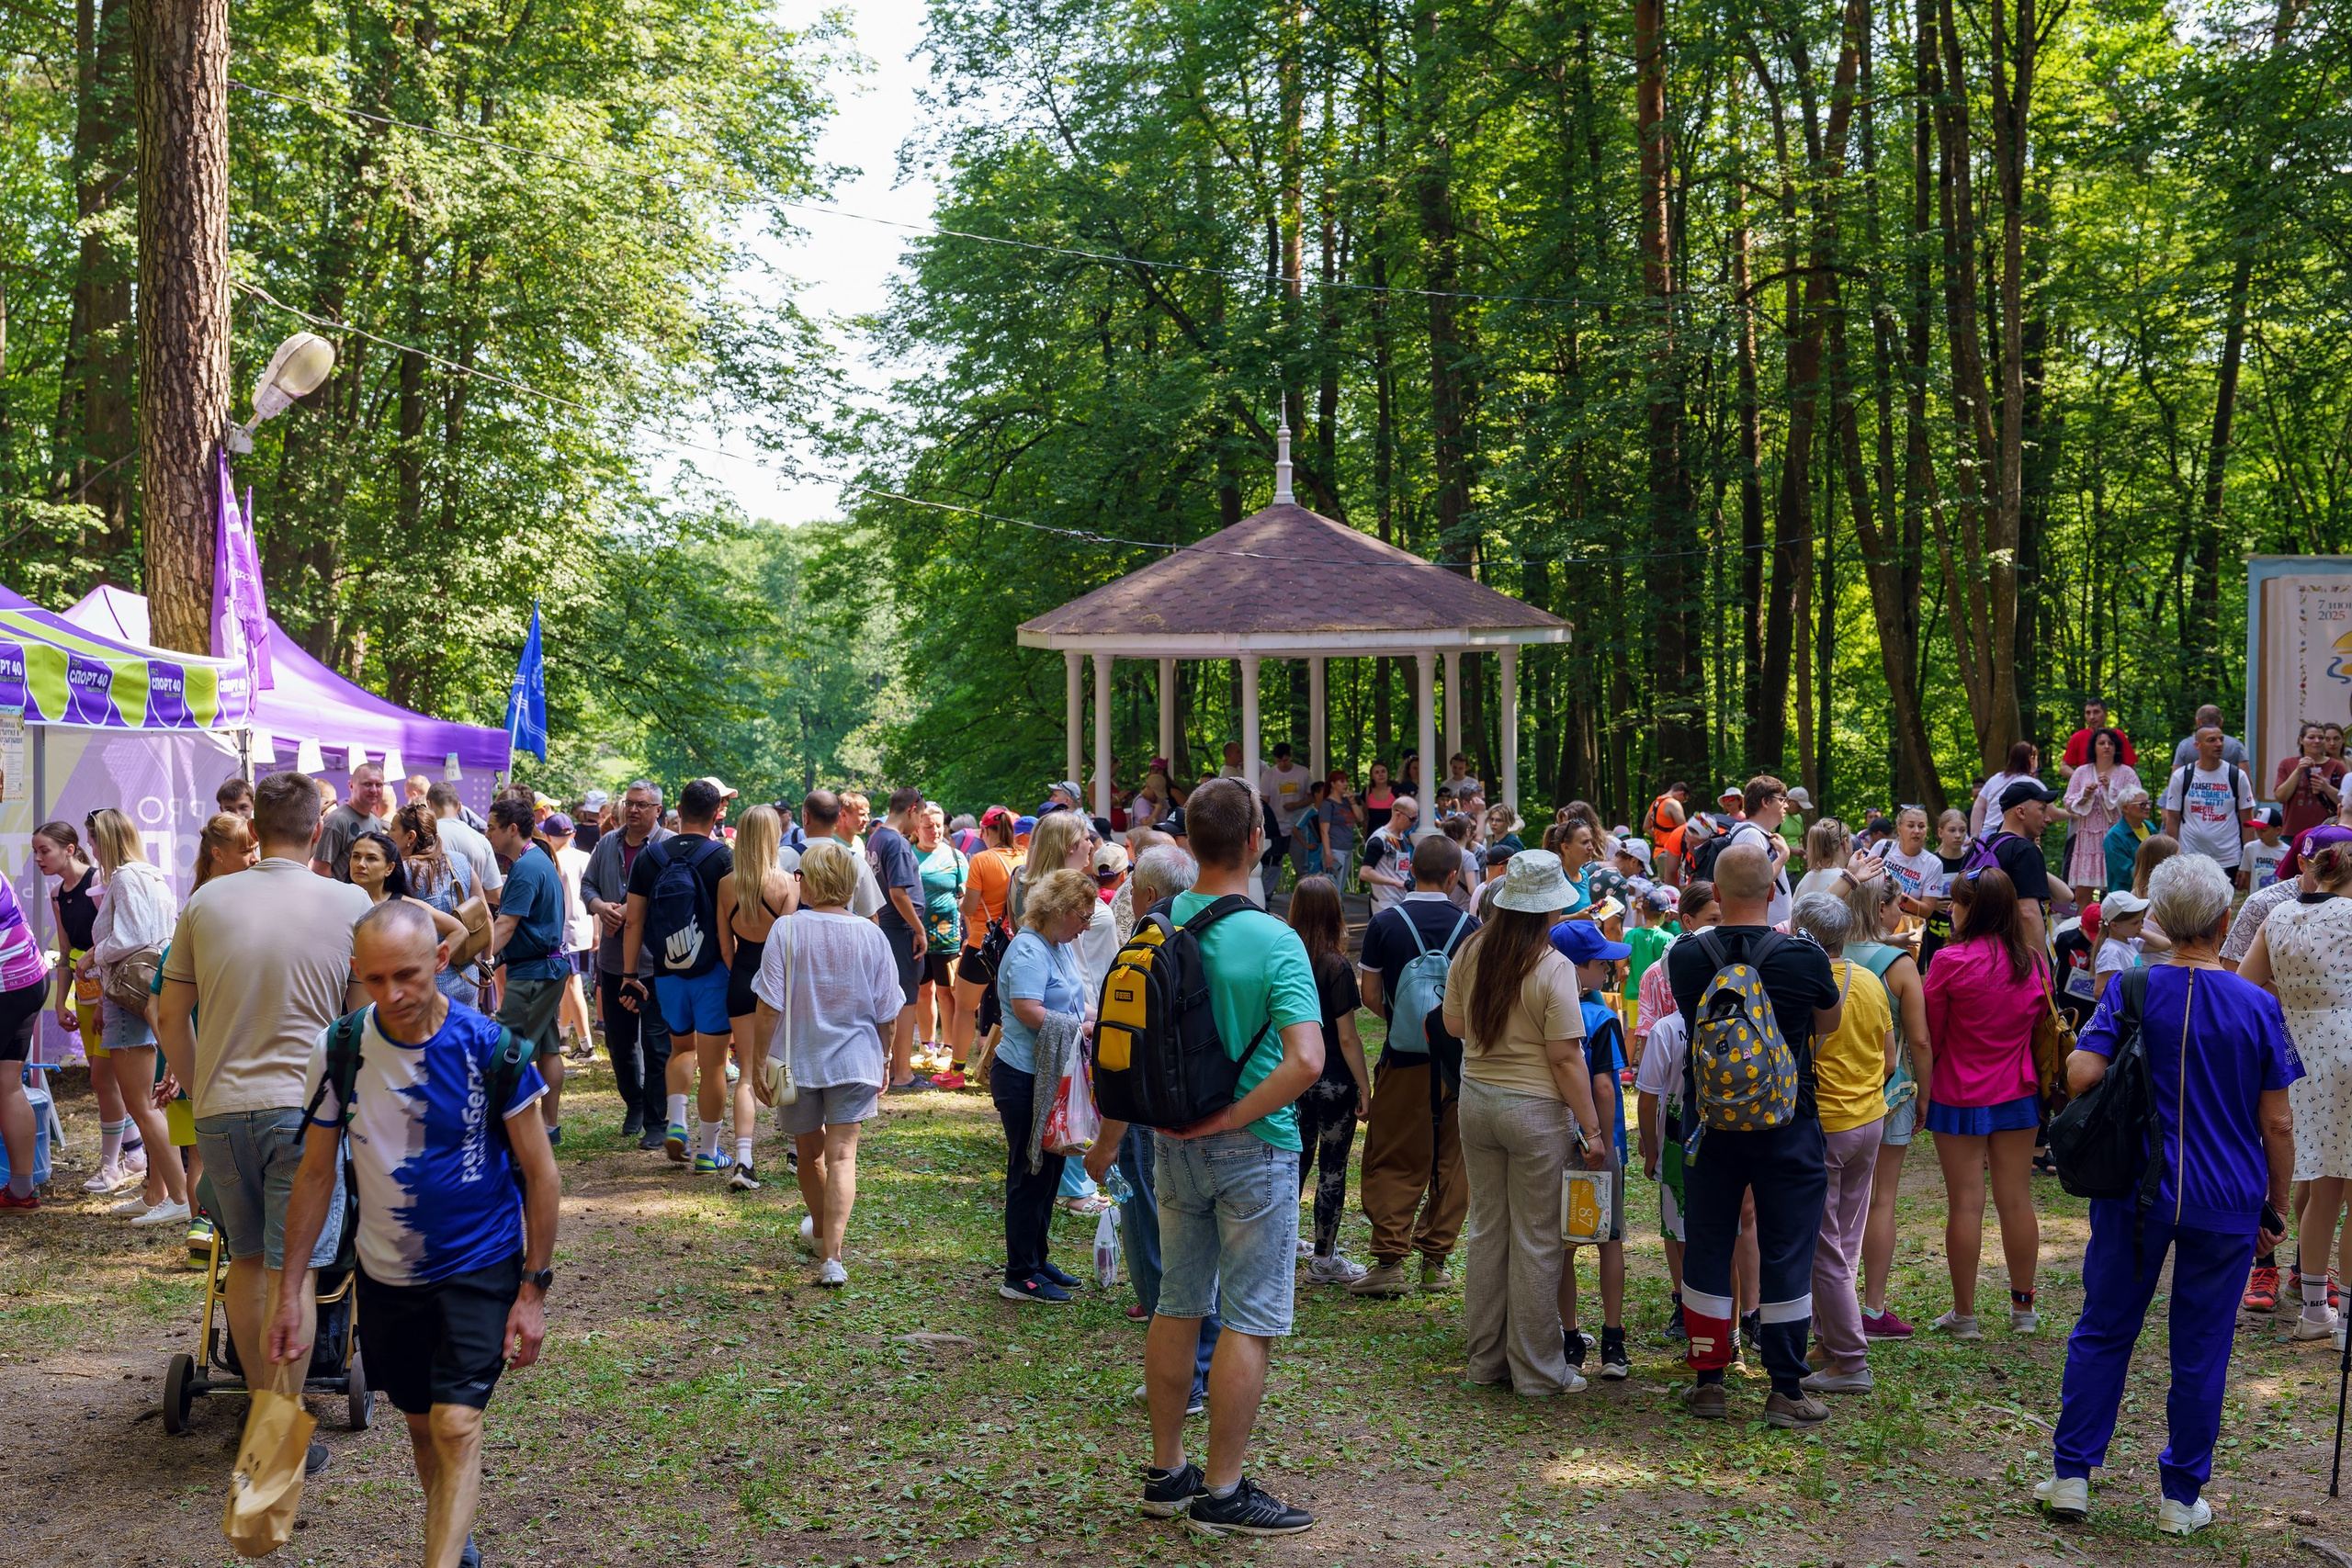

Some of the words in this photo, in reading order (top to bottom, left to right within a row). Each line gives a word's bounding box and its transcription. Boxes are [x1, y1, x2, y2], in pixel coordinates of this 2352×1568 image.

[2318, 599, 2326, 609] 7
[2318, 611, 2346, 621] 2025
[69, 670, 97, 686] СПОРТ
[97, 673, 108, 688] 40
[152, 677, 172, 692] СПОРТ
[173, 679, 182, 693] 40
[2200, 791, 2231, 799] ПЛАНЕТЫ
[2205, 798, 2224, 807] БЕГУТ
[2190, 805, 2214, 814] ВМЕСТЕ
[2208, 813, 2227, 822] ТОБОЙ
[1883, 860, 1922, 881] #ЗАБЕГ2025
[665, 913, 699, 961] NIKE
[79, 980, 99, 994] 334
[1581, 1183, 1589, 1194] 5K
[1568, 1193, 1579, 1223] Виктор
[1578, 1207, 1594, 1228] 87
